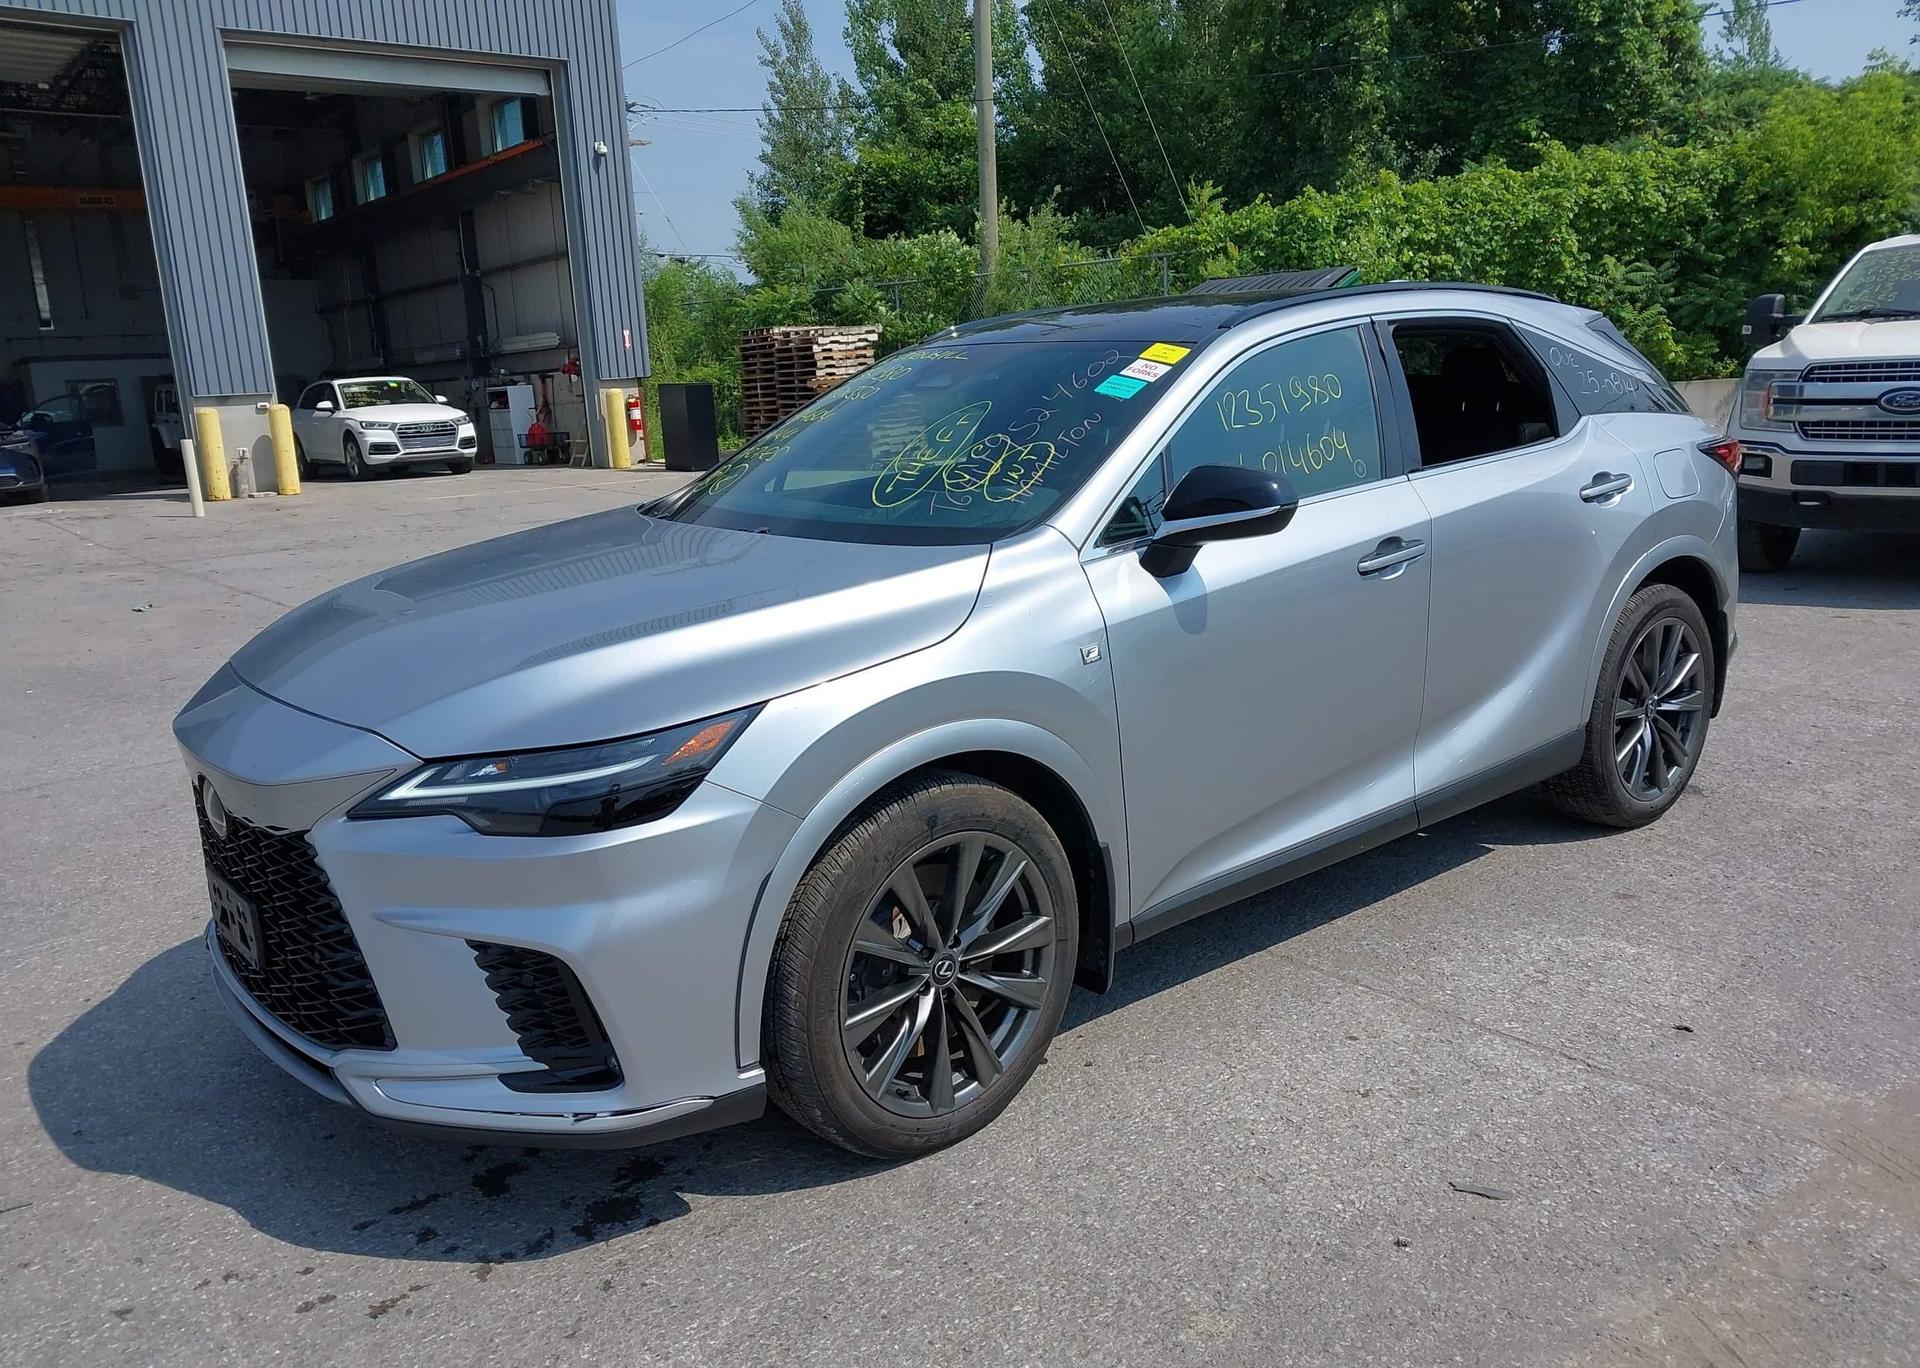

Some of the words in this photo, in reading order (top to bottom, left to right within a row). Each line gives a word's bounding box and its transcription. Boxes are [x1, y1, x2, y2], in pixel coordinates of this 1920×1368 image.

[1126, 367, 1159, 379] FORKS
[1141, 363, 1158, 371] NO
[1216, 373, 1342, 432] 12351980
